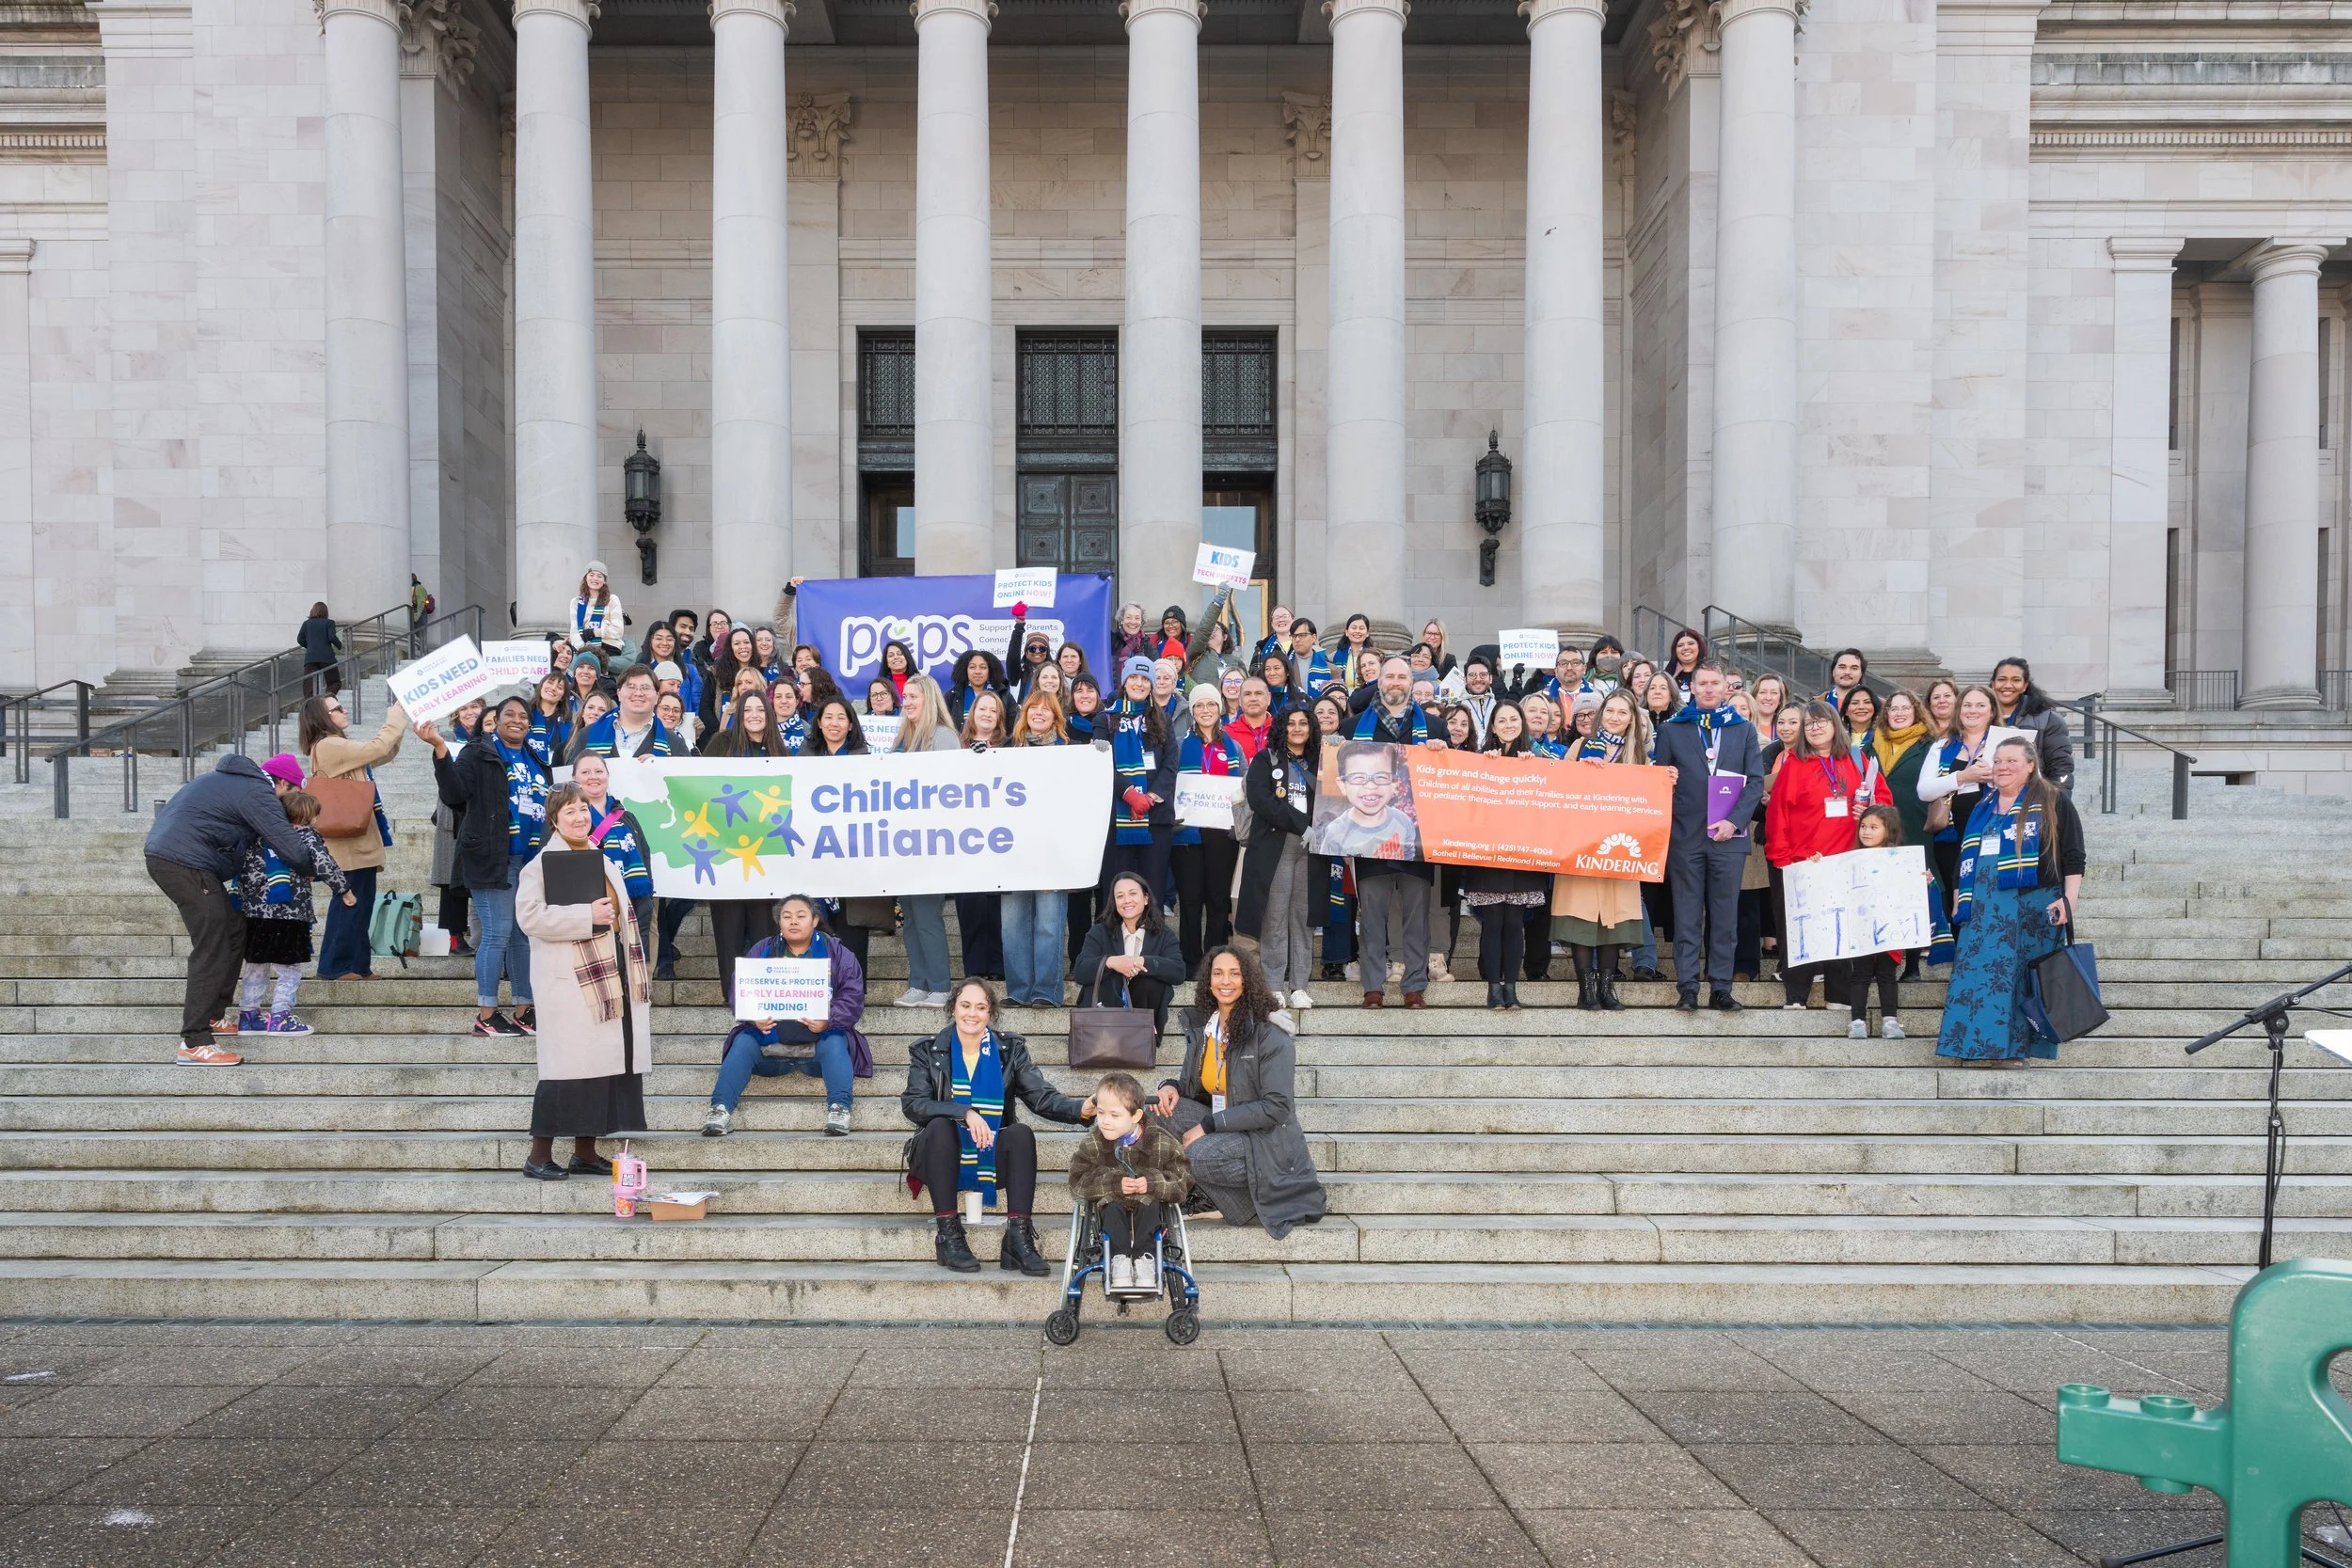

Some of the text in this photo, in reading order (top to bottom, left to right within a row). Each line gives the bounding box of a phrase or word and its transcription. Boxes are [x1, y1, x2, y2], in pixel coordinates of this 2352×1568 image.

[1211, 551, 1240, 568] KIDS
[1197, 569, 1215, 578] TECH
[997, 579, 1032, 589] PROTECT
[997, 590, 1052, 598] ONLINE NOW!
[485, 655, 548, 663] FAMILIES NEED
[521, 666, 548, 675] CARE
[403, 677, 440, 705] KIDS
[439, 657, 478, 689] NEED
[412, 673, 487, 719] EARLY LEARNING
[1416, 764, 1547, 786] Kids grow and change quickly!
[1417, 779, 1449, 789] Children
[1461, 783, 1470, 791] all
[1471, 784, 1498, 796] abilities
[1517, 788, 1534, 797] their
[1535, 788, 1564, 800] families
[1593, 793, 1629, 804] Kindering
[1631, 796, 1647, 804] with
[1434, 791, 1467, 801] pediatric
[1468, 794, 1503, 806] therapies,
[1505, 798, 1530, 807] family
[1563, 801, 1579, 810] and
[1580, 803, 1599, 813] early
[1599, 804, 1631, 815] learning
[1633, 807, 1663, 816] services.
[811, 818, 1014, 860] Alliance
[1442, 839, 1553, 856] Kindering.org (425) 747-4004
[1432, 848, 1457, 858] Bothell
[1462, 852, 1492, 862] Bellevue
[1497, 856, 1531, 865] Redmond
[1575, 853, 1659, 876] KINDERING
[774, 990, 825, 998] LEARNING
[757, 1003, 807, 1011] FUNDING!
